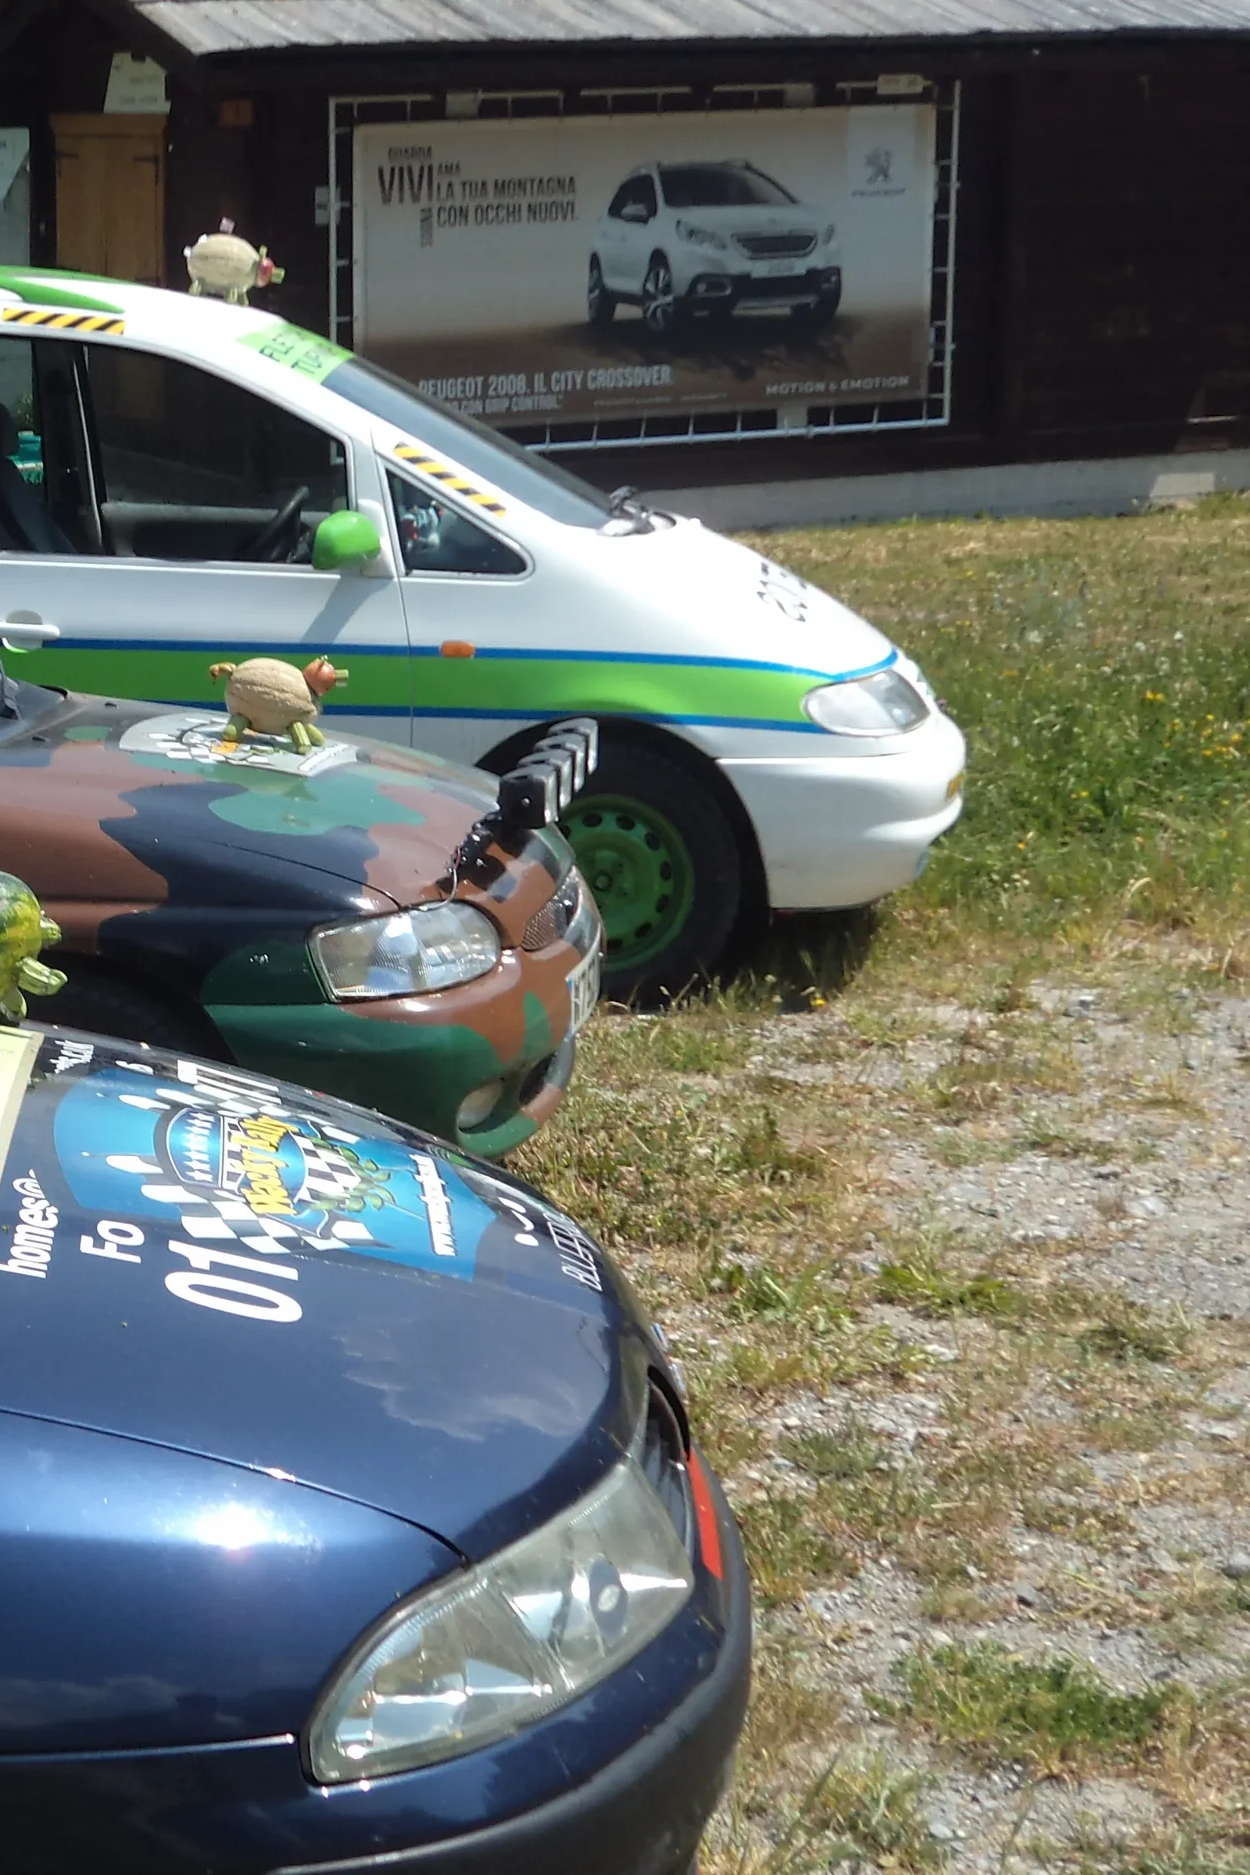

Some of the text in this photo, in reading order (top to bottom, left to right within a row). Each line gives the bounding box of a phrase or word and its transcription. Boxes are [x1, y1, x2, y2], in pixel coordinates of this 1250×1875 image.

[377, 163, 434, 206] VIVI
[436, 175, 577, 201] LA TUA MONTAGNA
[436, 204, 470, 228] CON
[474, 202, 522, 227] OCCHI
[533, 371, 548, 393] IL
[550, 369, 584, 392] CITY
[765, 381, 826, 396] MOTION
[840, 374, 910, 391] EMOTION
